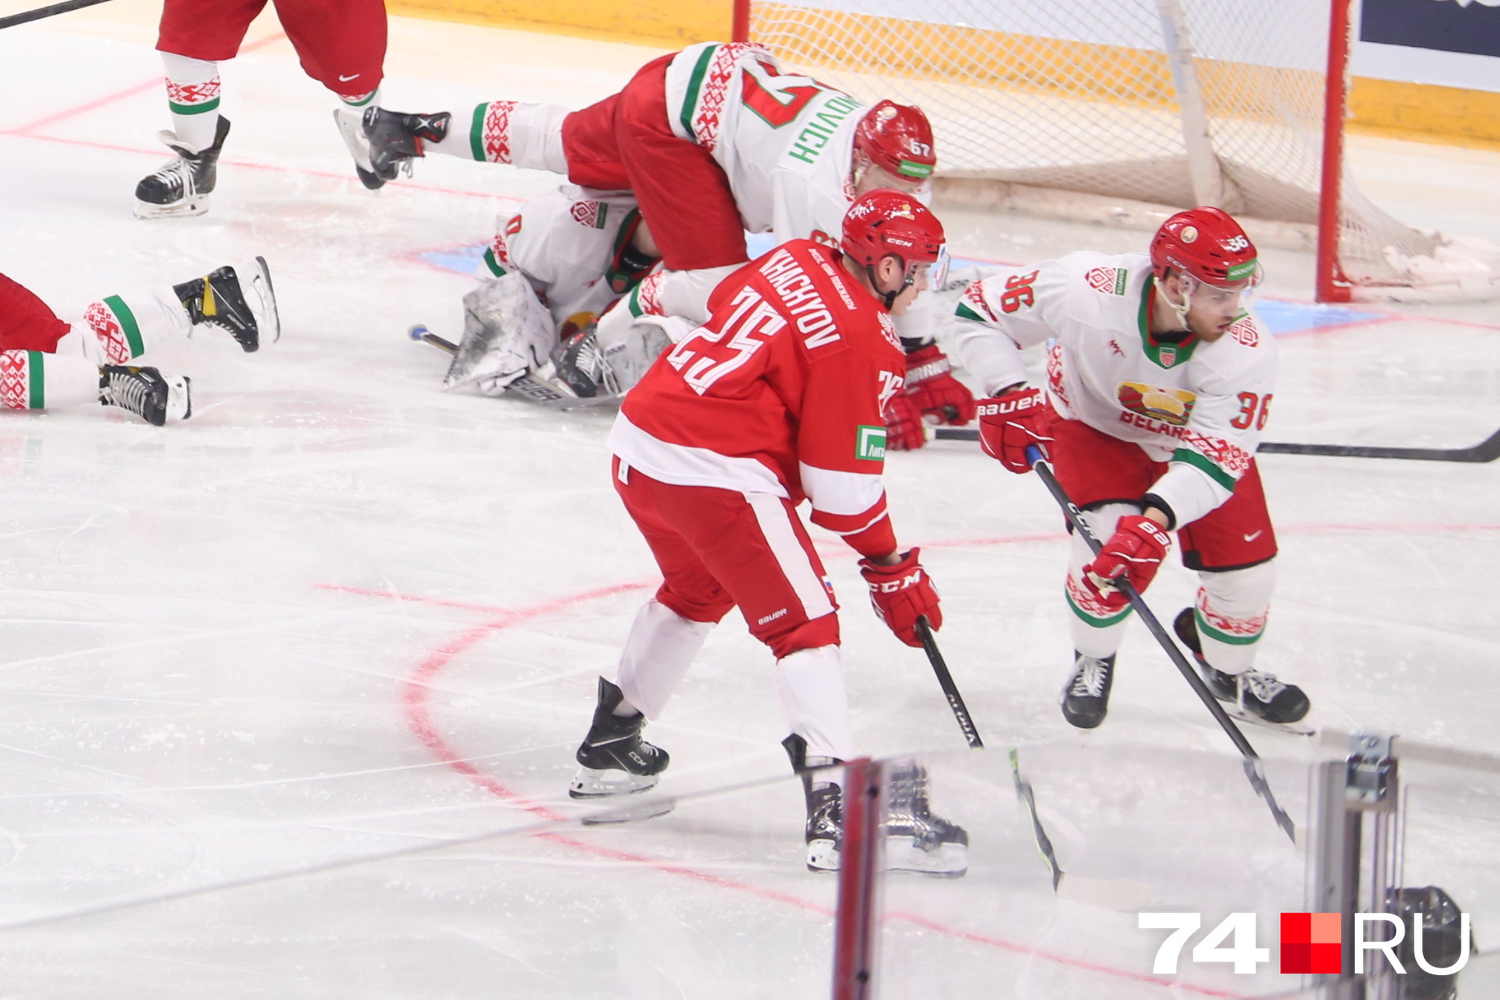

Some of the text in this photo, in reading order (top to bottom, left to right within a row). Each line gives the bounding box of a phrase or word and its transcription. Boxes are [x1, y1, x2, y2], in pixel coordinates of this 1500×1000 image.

[909, 140, 931, 156] 67
[885, 236, 913, 248] CCM
[1226, 234, 1249, 251] 36
[1165, 255, 1188, 271] CCM
[999, 268, 1041, 315] 36
[666, 284, 789, 396] 25
[975, 391, 1047, 418] BAUER
[757, 607, 788, 627] BAUER
[627, 750, 648, 767] CCM
